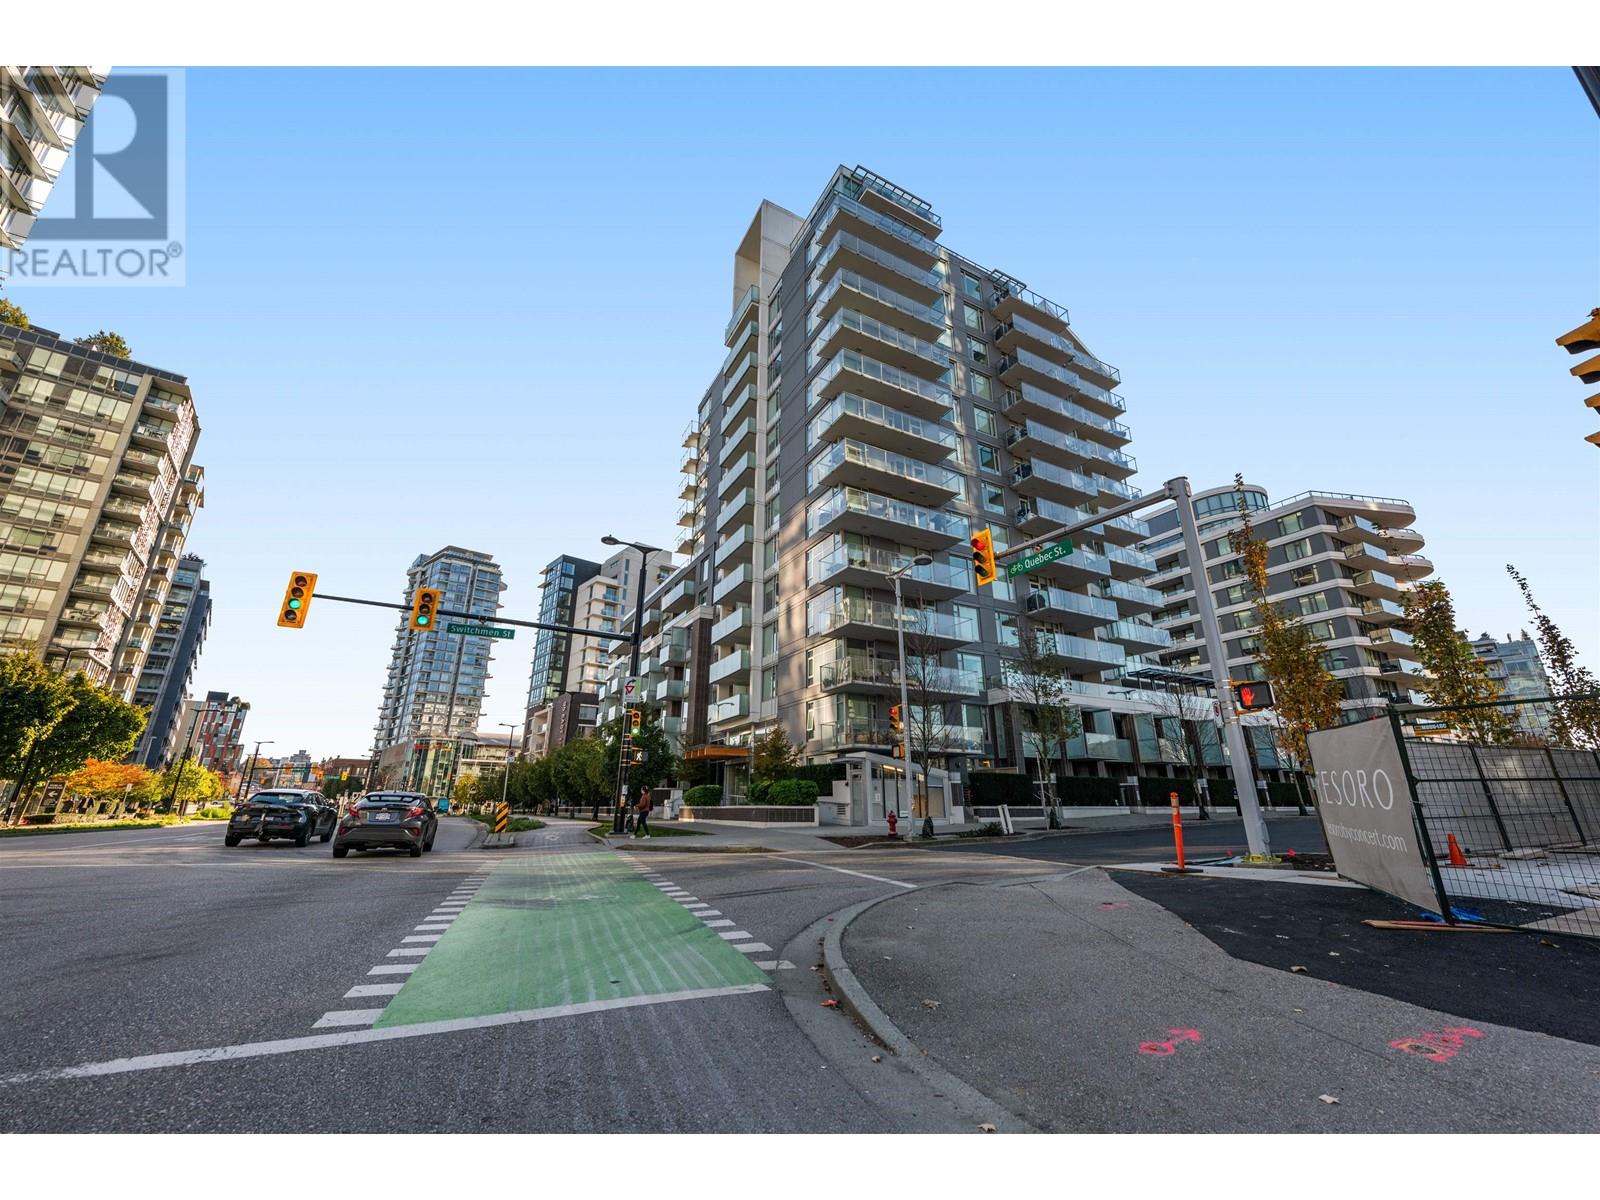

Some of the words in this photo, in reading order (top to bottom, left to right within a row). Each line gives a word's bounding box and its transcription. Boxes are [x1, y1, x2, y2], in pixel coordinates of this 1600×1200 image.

[1024, 550, 1053, 569] Quebec
[1054, 546, 1067, 558] St.
[450, 625, 500, 637] Switchmen
[502, 630, 511, 638] St
